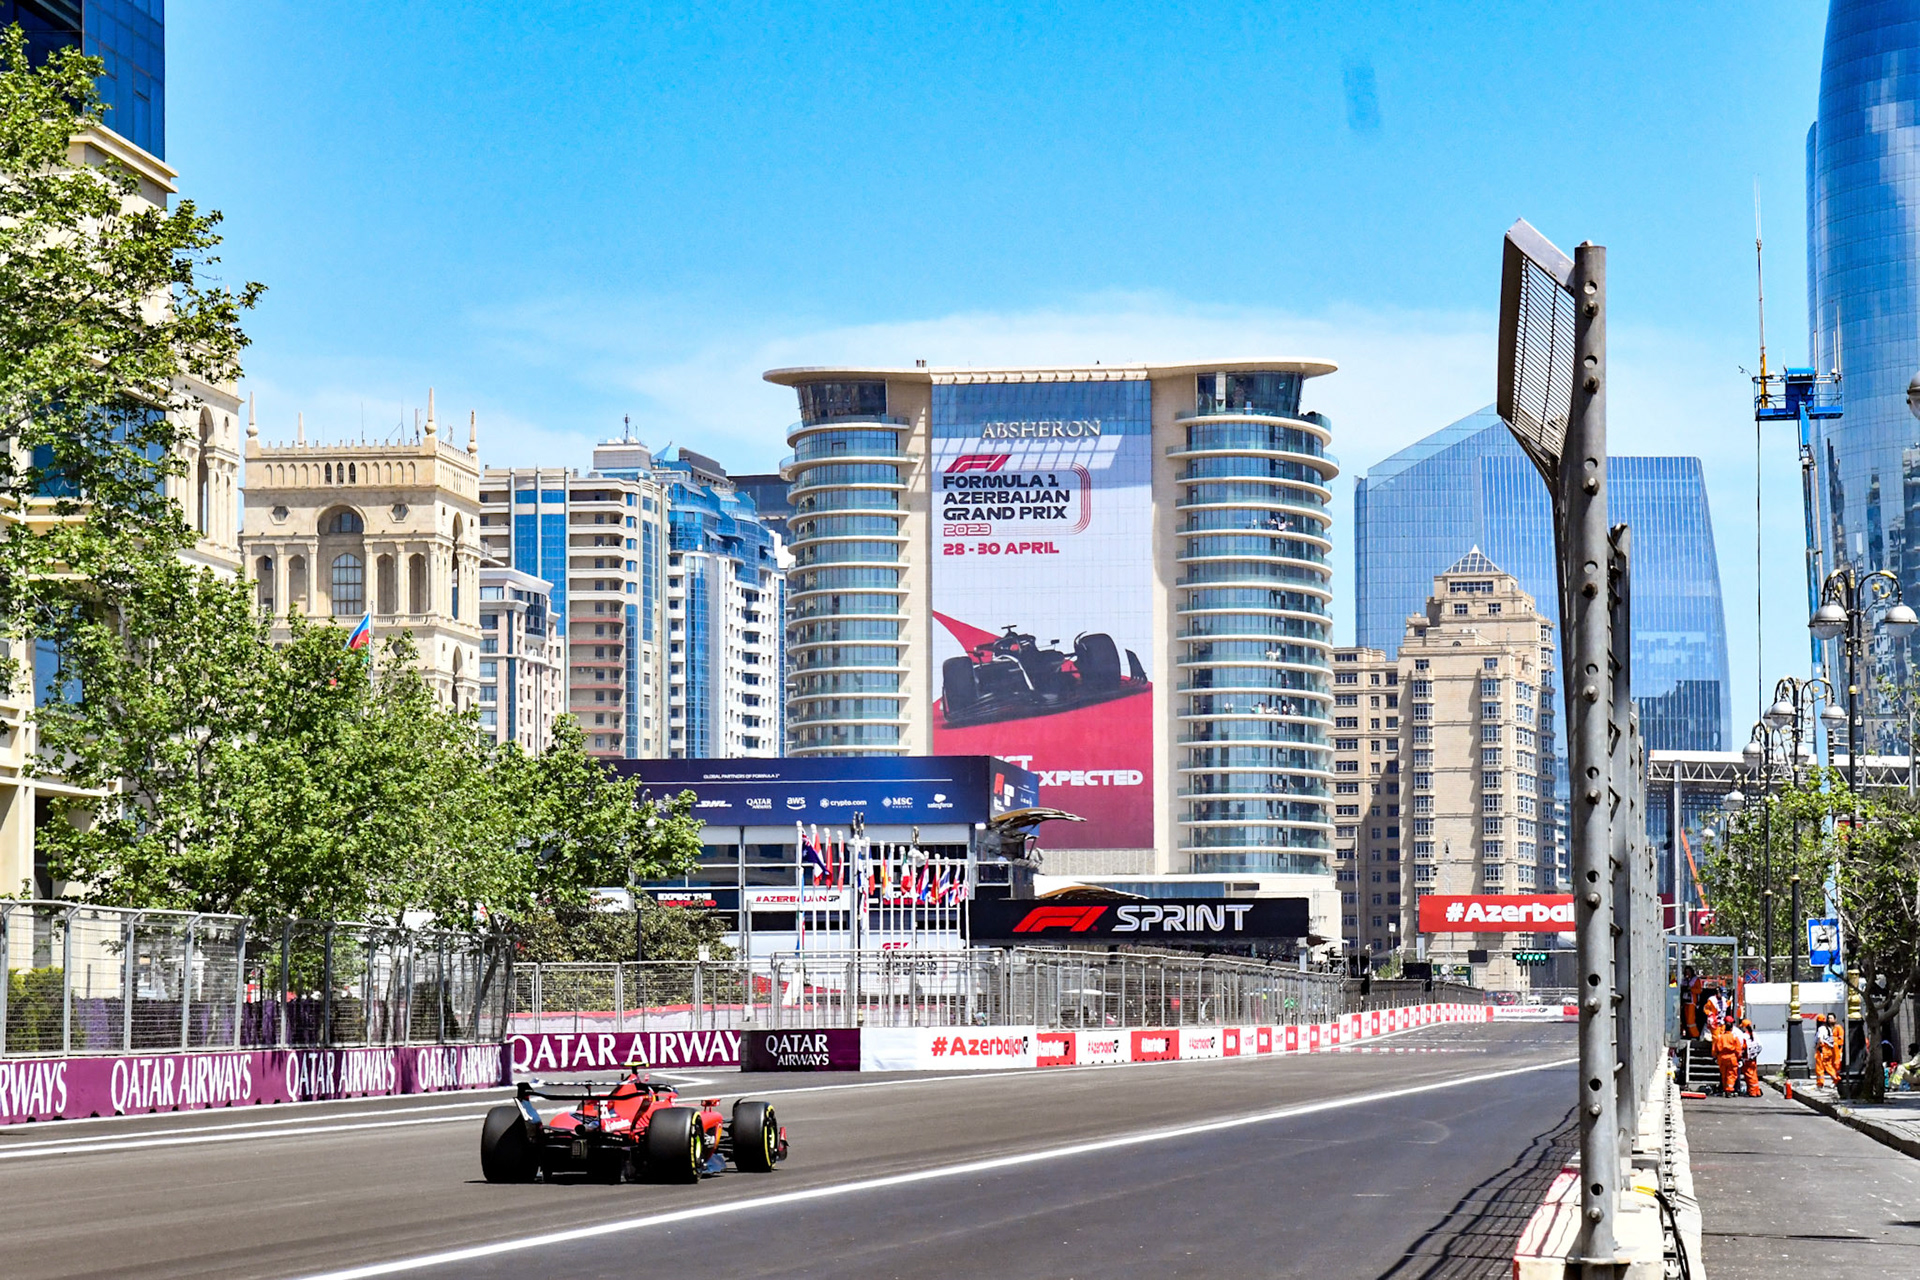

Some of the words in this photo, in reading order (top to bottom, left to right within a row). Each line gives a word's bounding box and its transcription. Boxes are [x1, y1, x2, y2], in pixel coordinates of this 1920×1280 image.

[982, 420, 1101, 438] ABSHERON
[943, 475, 1043, 489] FORMULA
[1048, 474, 1059, 488] 1
[943, 490, 1070, 505] AZERBAIJAN
[943, 507, 1015, 521] GRAND
[1019, 505, 1067, 520] PRIX
[943, 523, 992, 537] 2023
[943, 543, 965, 556] 28
[978, 542, 1001, 555] 30
[1005, 542, 1060, 555] APRIL
[1032, 770, 1143, 787] XPECTED
[746, 798, 772, 806] QATAR
[830, 799, 867, 807] crypto.com
[892, 797, 913, 806] MSC
[1111, 904, 1254, 932] SPRINT
[508, 1033, 617, 1073] QATAR
[765, 1034, 829, 1057] QATAR
[777, 1053, 830, 1066] AIRWAYS
[286, 1051, 335, 1102] QATAR
[338, 1049, 395, 1093] AIRWAYS
[418, 1048, 458, 1090] QATAR
[459, 1046, 502, 1086] AIRWAYS
[0, 1062, 67, 1117] RWAYS
[111, 1059, 175, 1115] QATAR
[177, 1054, 252, 1105] AIRWAYS
